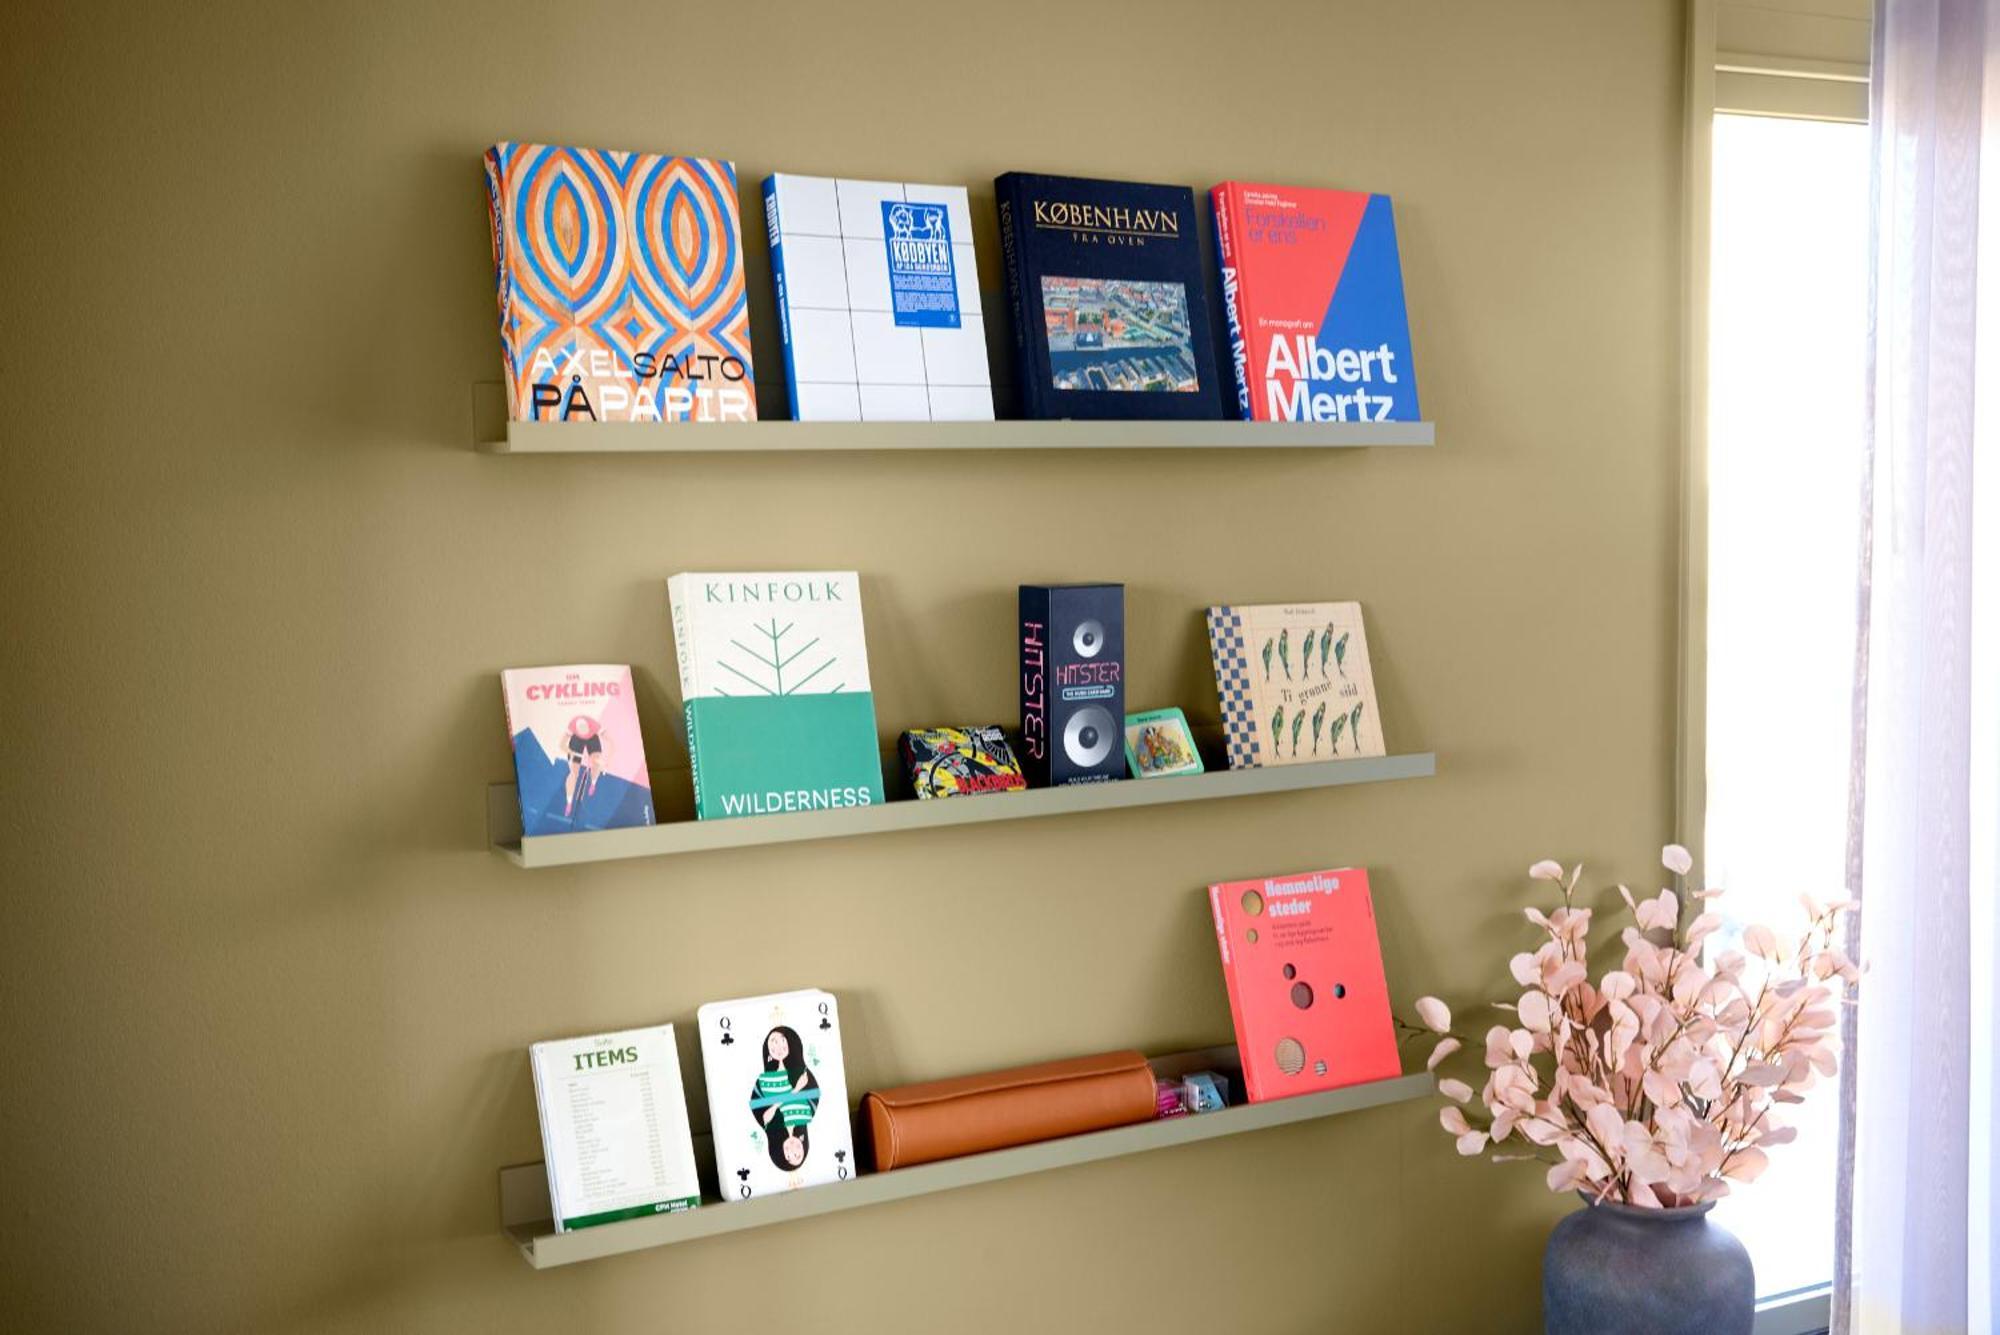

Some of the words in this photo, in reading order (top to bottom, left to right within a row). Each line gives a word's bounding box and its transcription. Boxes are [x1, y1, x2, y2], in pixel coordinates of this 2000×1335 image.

[1034, 201, 1178, 232] KØBENHAVN
[1073, 233, 1099, 245] FRA
[1107, 235, 1145, 246] OVEN
[893, 240, 948, 264] KØDBYEN
[1221, 266, 1242, 338] Albert
[531, 348, 633, 379] AXEL
[633, 352, 746, 382] SALTO
[1265, 333, 1398, 384] Albert
[1231, 338, 1249, 411] Mertz
[532, 374, 597, 421] PÅ
[600, 386, 749, 421] PAPIR
[1265, 379, 1395, 422] Mertz
[706, 582, 842, 603] KINFOLK
[1056, 662, 1120, 686] HITSTER
[526, 682, 621, 701] CYKLING
[1024, 621, 1044, 760] HITSTER
[1281, 688, 1293, 702] Ti
[721, 786, 872, 815] WILDERNESS
[1265, 875, 1340, 896] Hemmelige
[1269, 898, 1312, 917] steder
[818, 1002, 829, 1016] Q
[720, 1016, 731, 1030] Q
[573, 1046, 639, 1071] ITEMS
[838, 1166, 848, 1180] Q
[740, 1184, 752, 1199] Q
